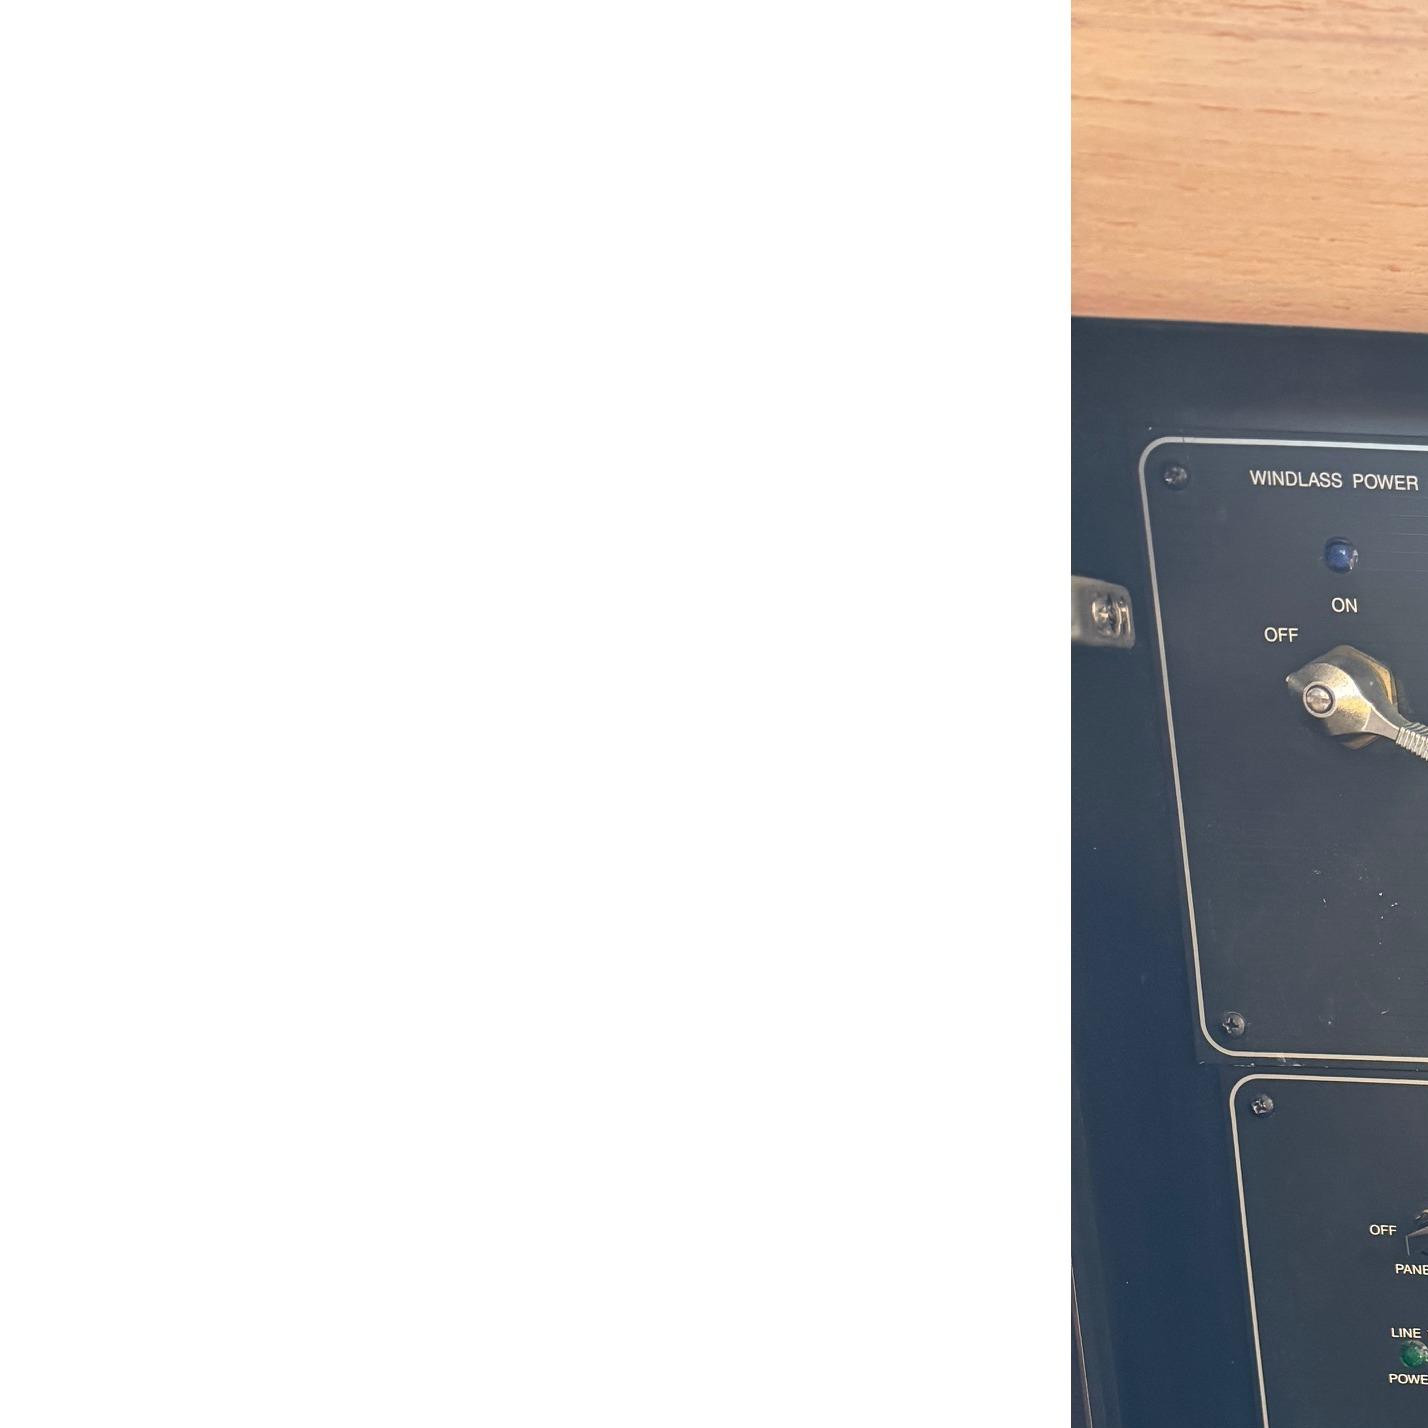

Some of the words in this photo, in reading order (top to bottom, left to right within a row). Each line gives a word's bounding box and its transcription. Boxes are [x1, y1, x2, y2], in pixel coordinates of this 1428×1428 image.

[1250, 469, 1342, 489] WINDLASS
[1353, 472, 1419, 491] POWER
[1331, 597, 1358, 613] ON
[1264, 627, 1298, 642] OFF
[1369, 1225, 1397, 1236] OFF
[1391, 1328, 1422, 1339] LINE
